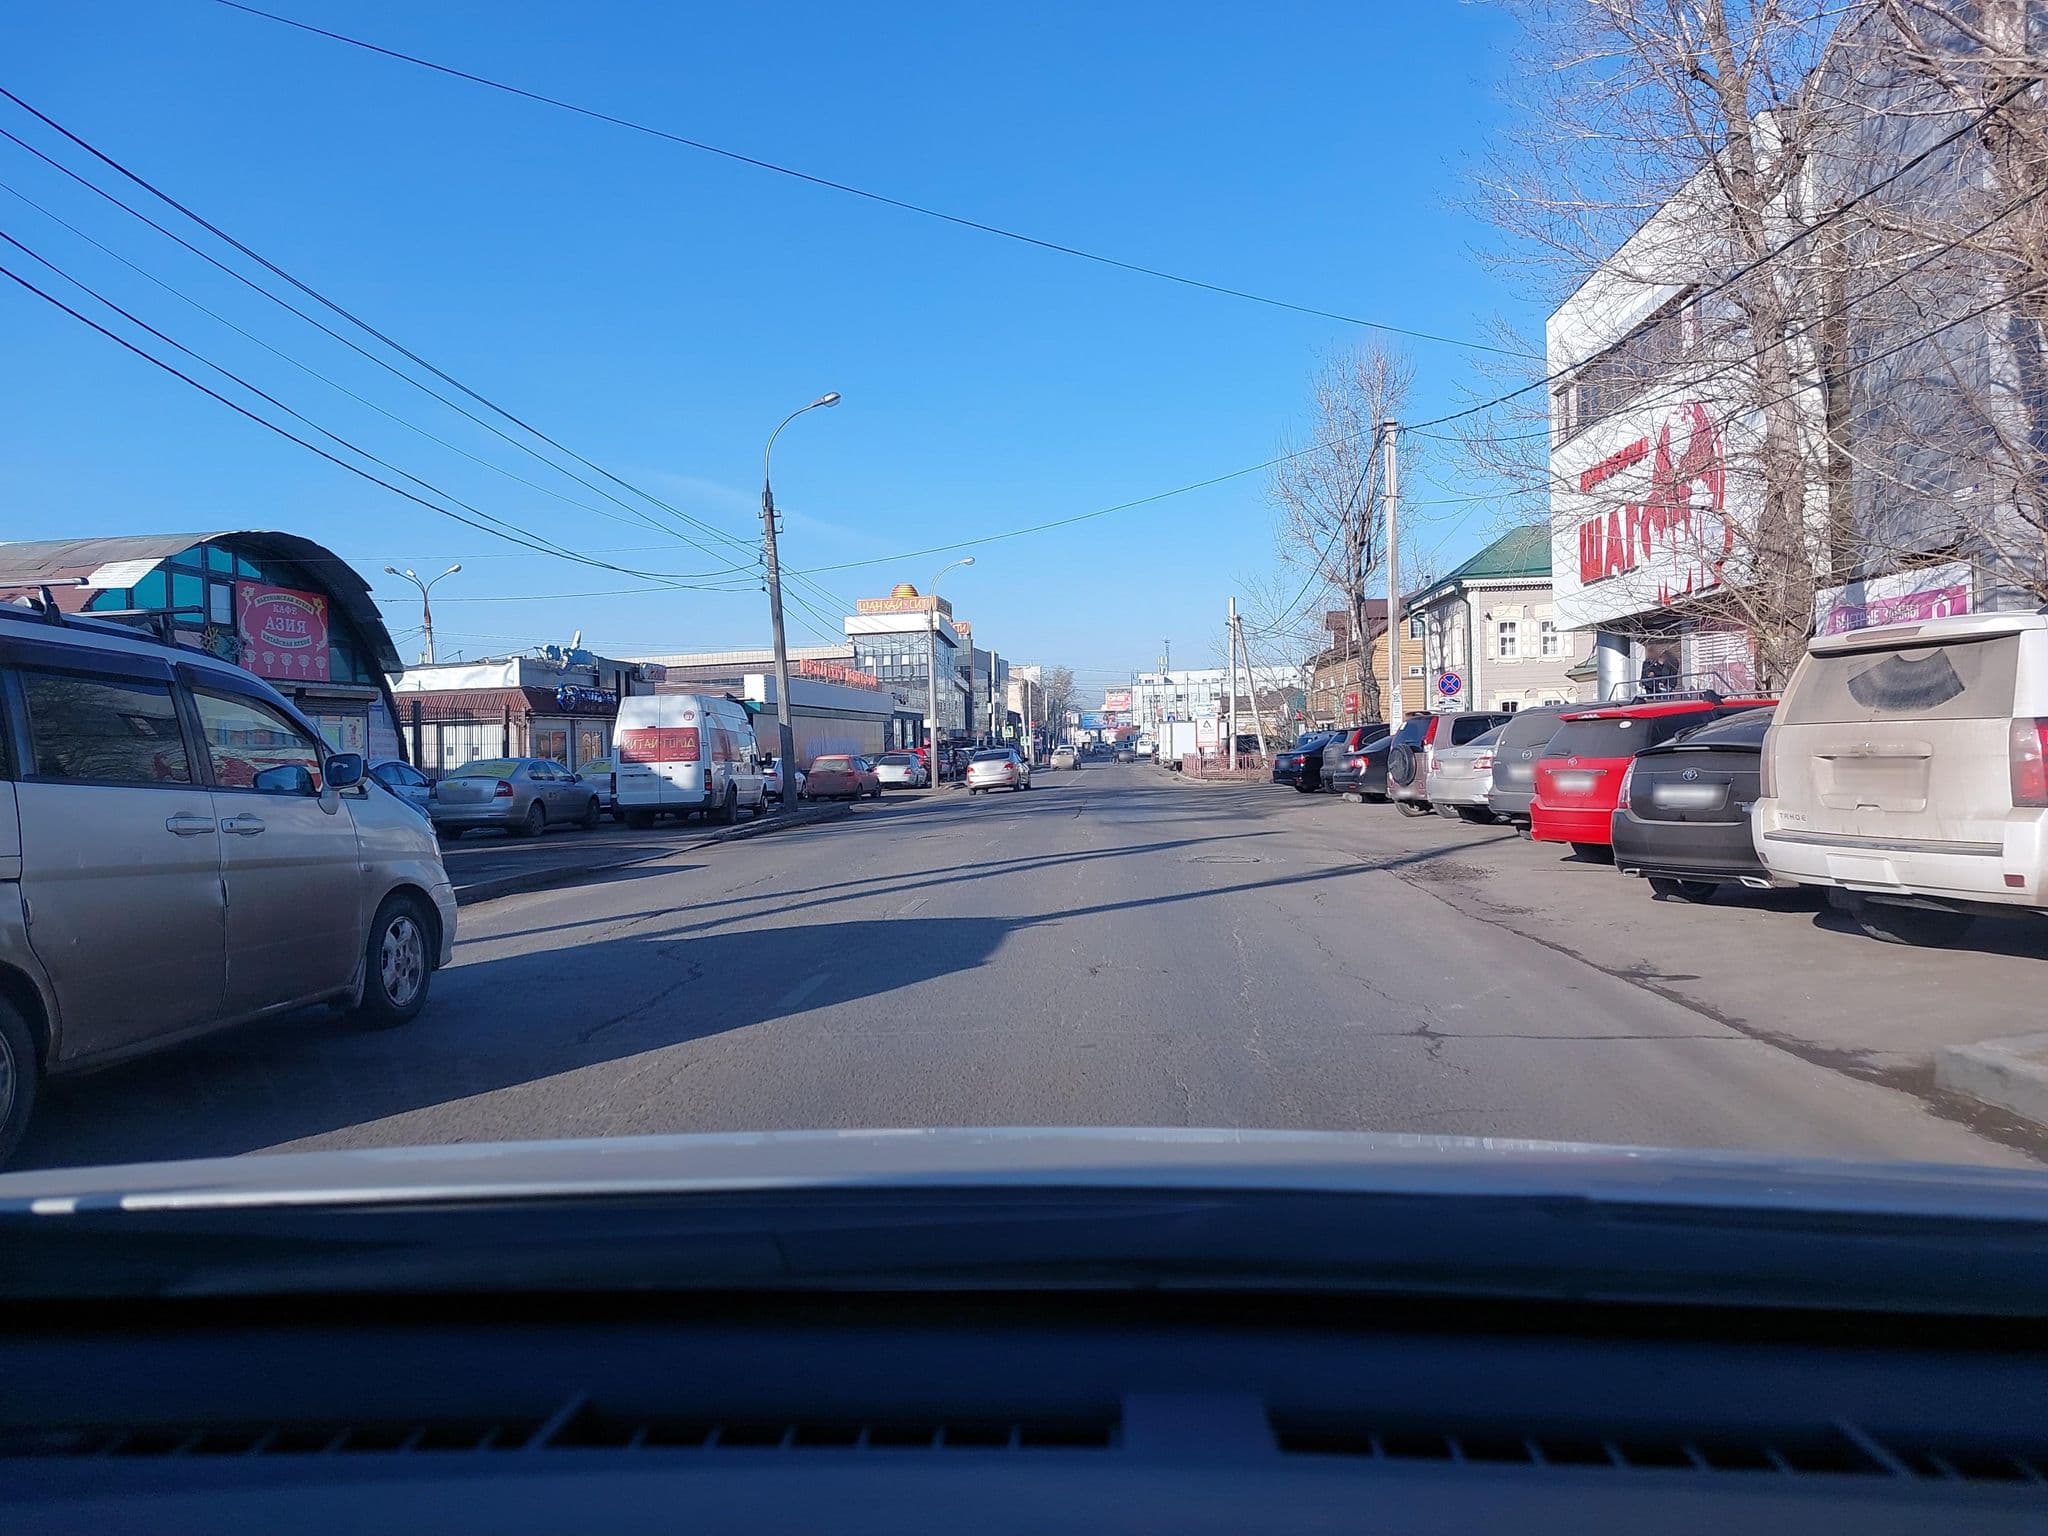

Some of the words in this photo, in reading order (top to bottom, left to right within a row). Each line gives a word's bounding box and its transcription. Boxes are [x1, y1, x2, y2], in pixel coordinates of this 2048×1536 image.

[272, 603, 298, 616] КАФЕ
[859, 600, 903, 611] ШАНХАЙ
[264, 615, 306, 633] АЗИЯ
[1778, 812, 1808, 821] TAHOE
